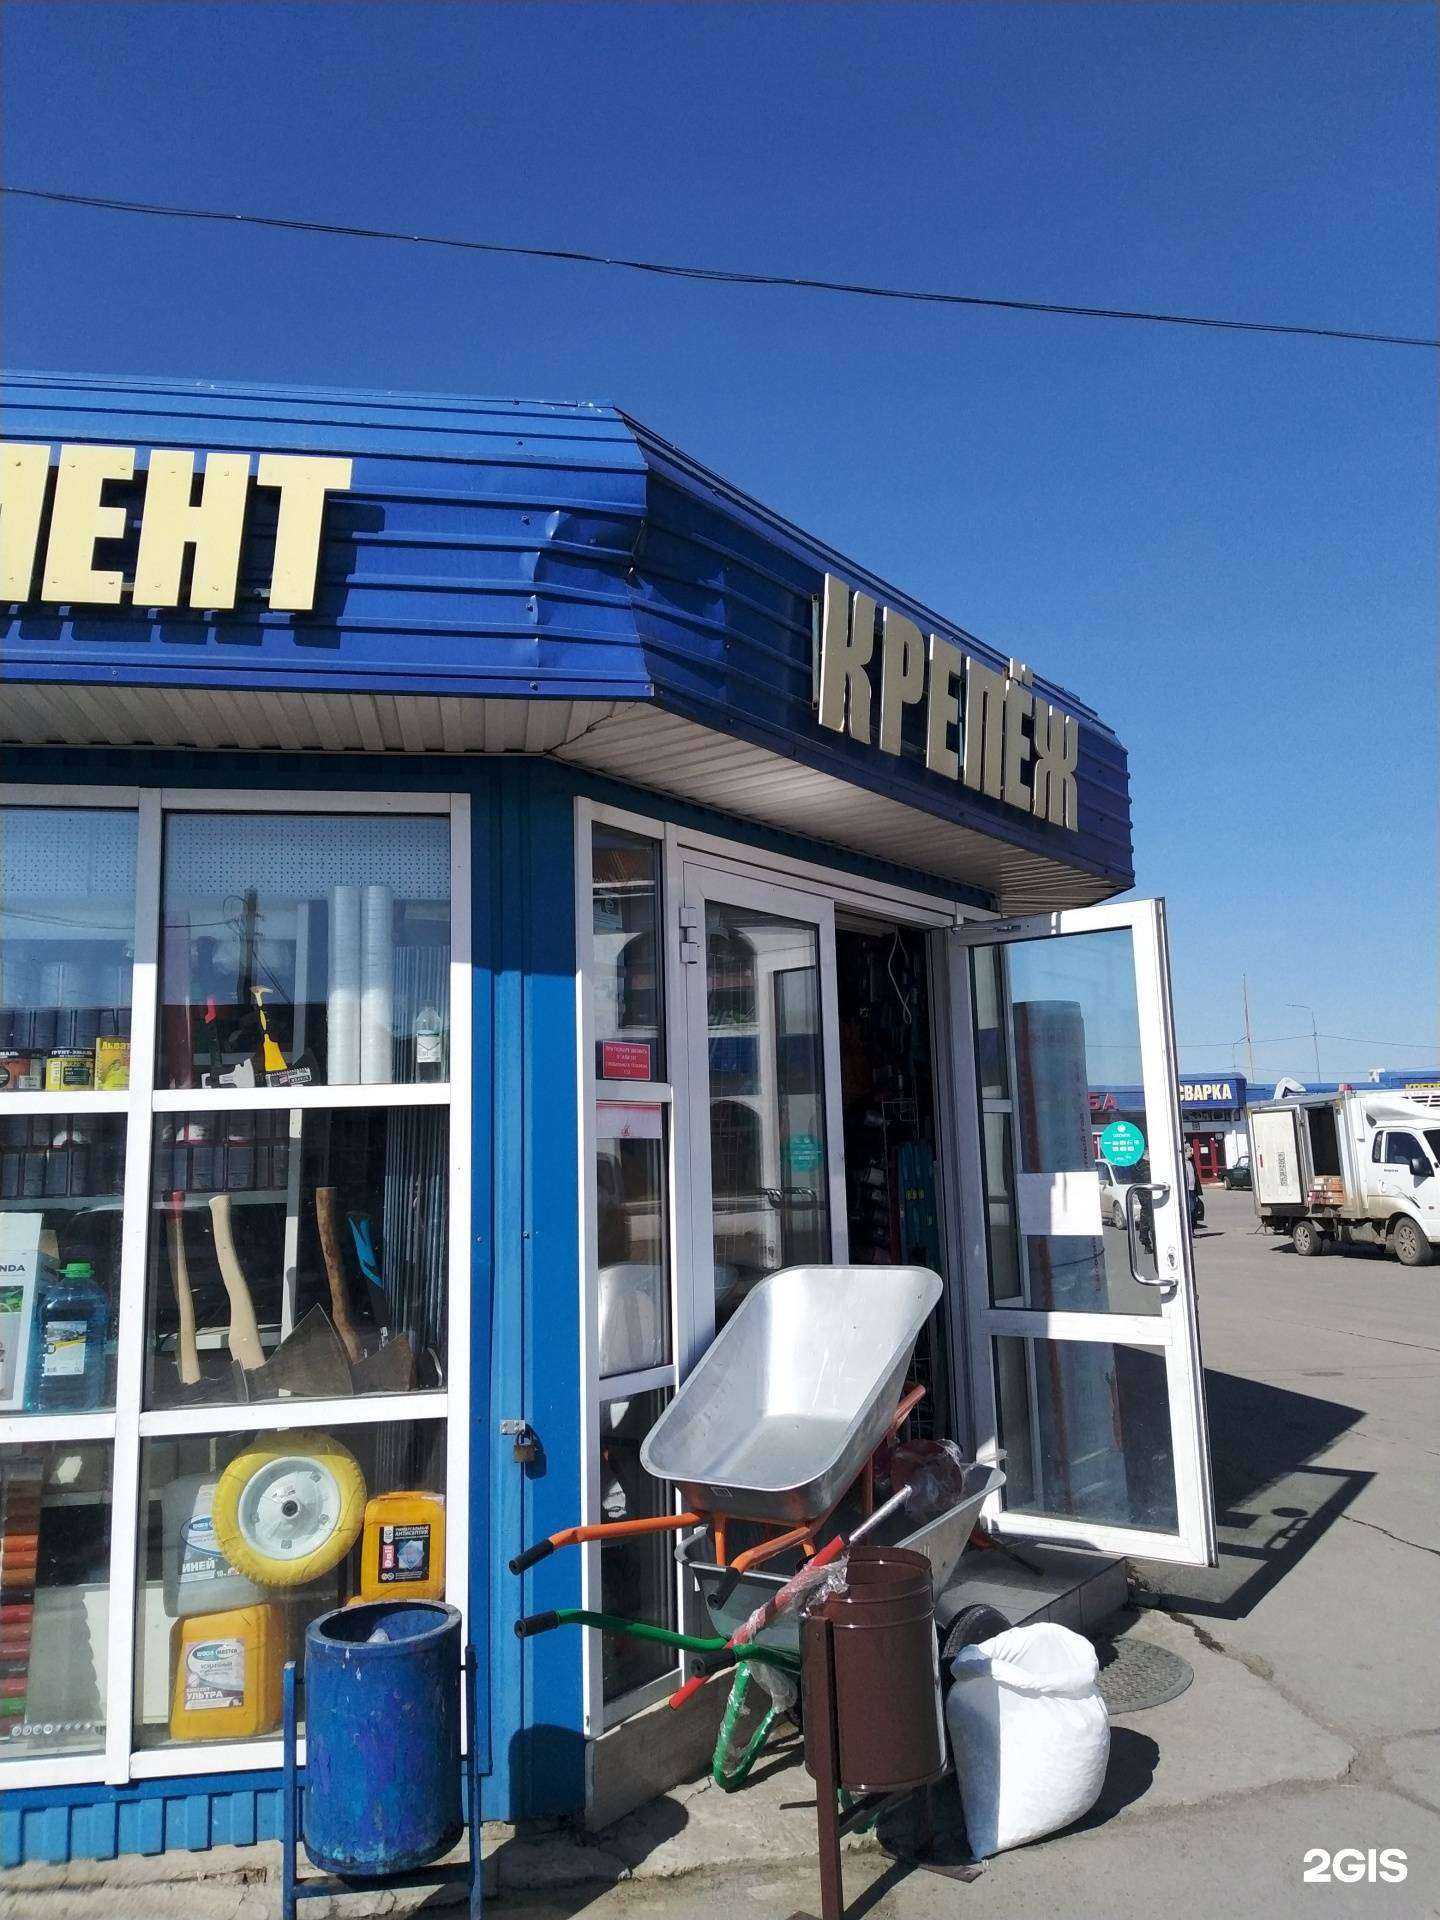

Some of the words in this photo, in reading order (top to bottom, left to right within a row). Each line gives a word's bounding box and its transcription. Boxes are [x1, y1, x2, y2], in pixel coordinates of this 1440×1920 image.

[818, 572, 1079, 833] КРЕПЁЖ
[1179, 1083, 1232, 1101] СВАРКА
[182, 1557, 216, 1573] ИНЕЙ
[186, 1690, 223, 1700] УЛЬТРА
